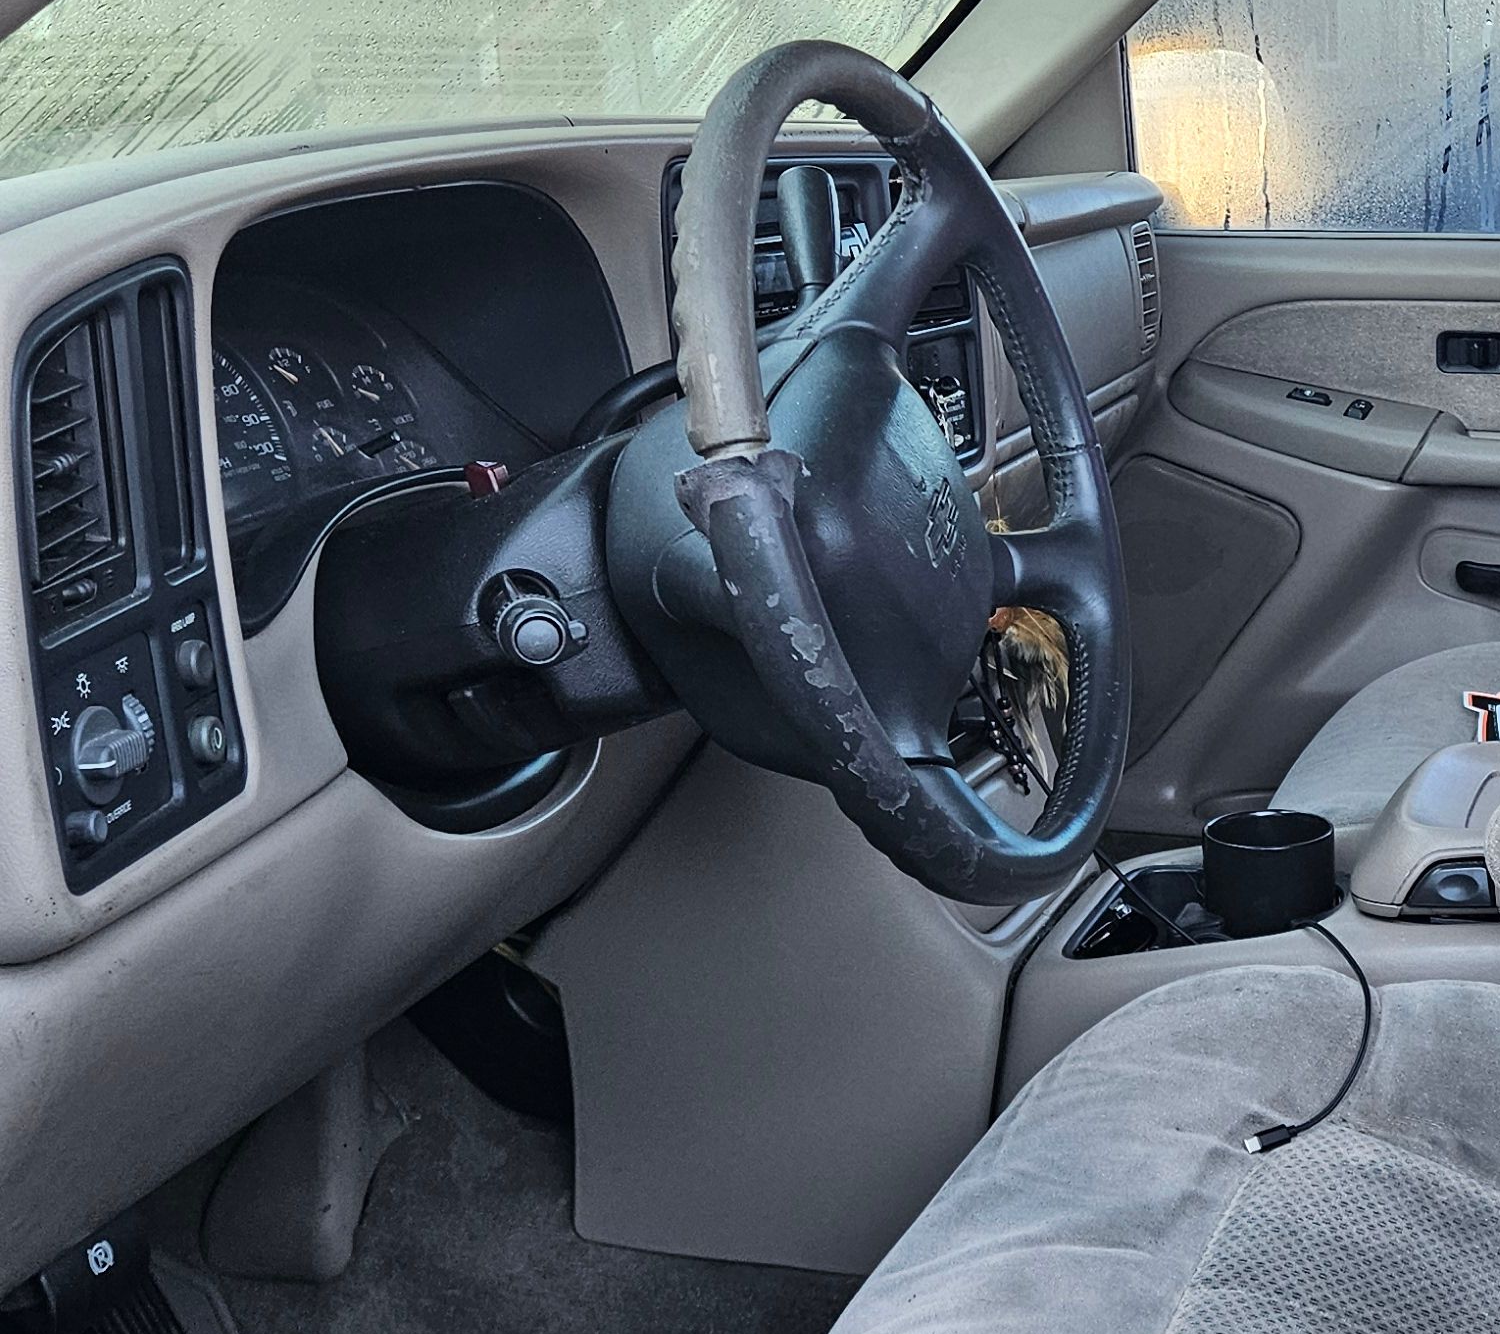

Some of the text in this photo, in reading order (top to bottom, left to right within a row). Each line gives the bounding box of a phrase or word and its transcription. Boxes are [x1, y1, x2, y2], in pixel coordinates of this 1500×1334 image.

[221, 383, 240, 397] 80
[316, 398, 335, 411] FUEL
[241, 413, 261, 427] 90
